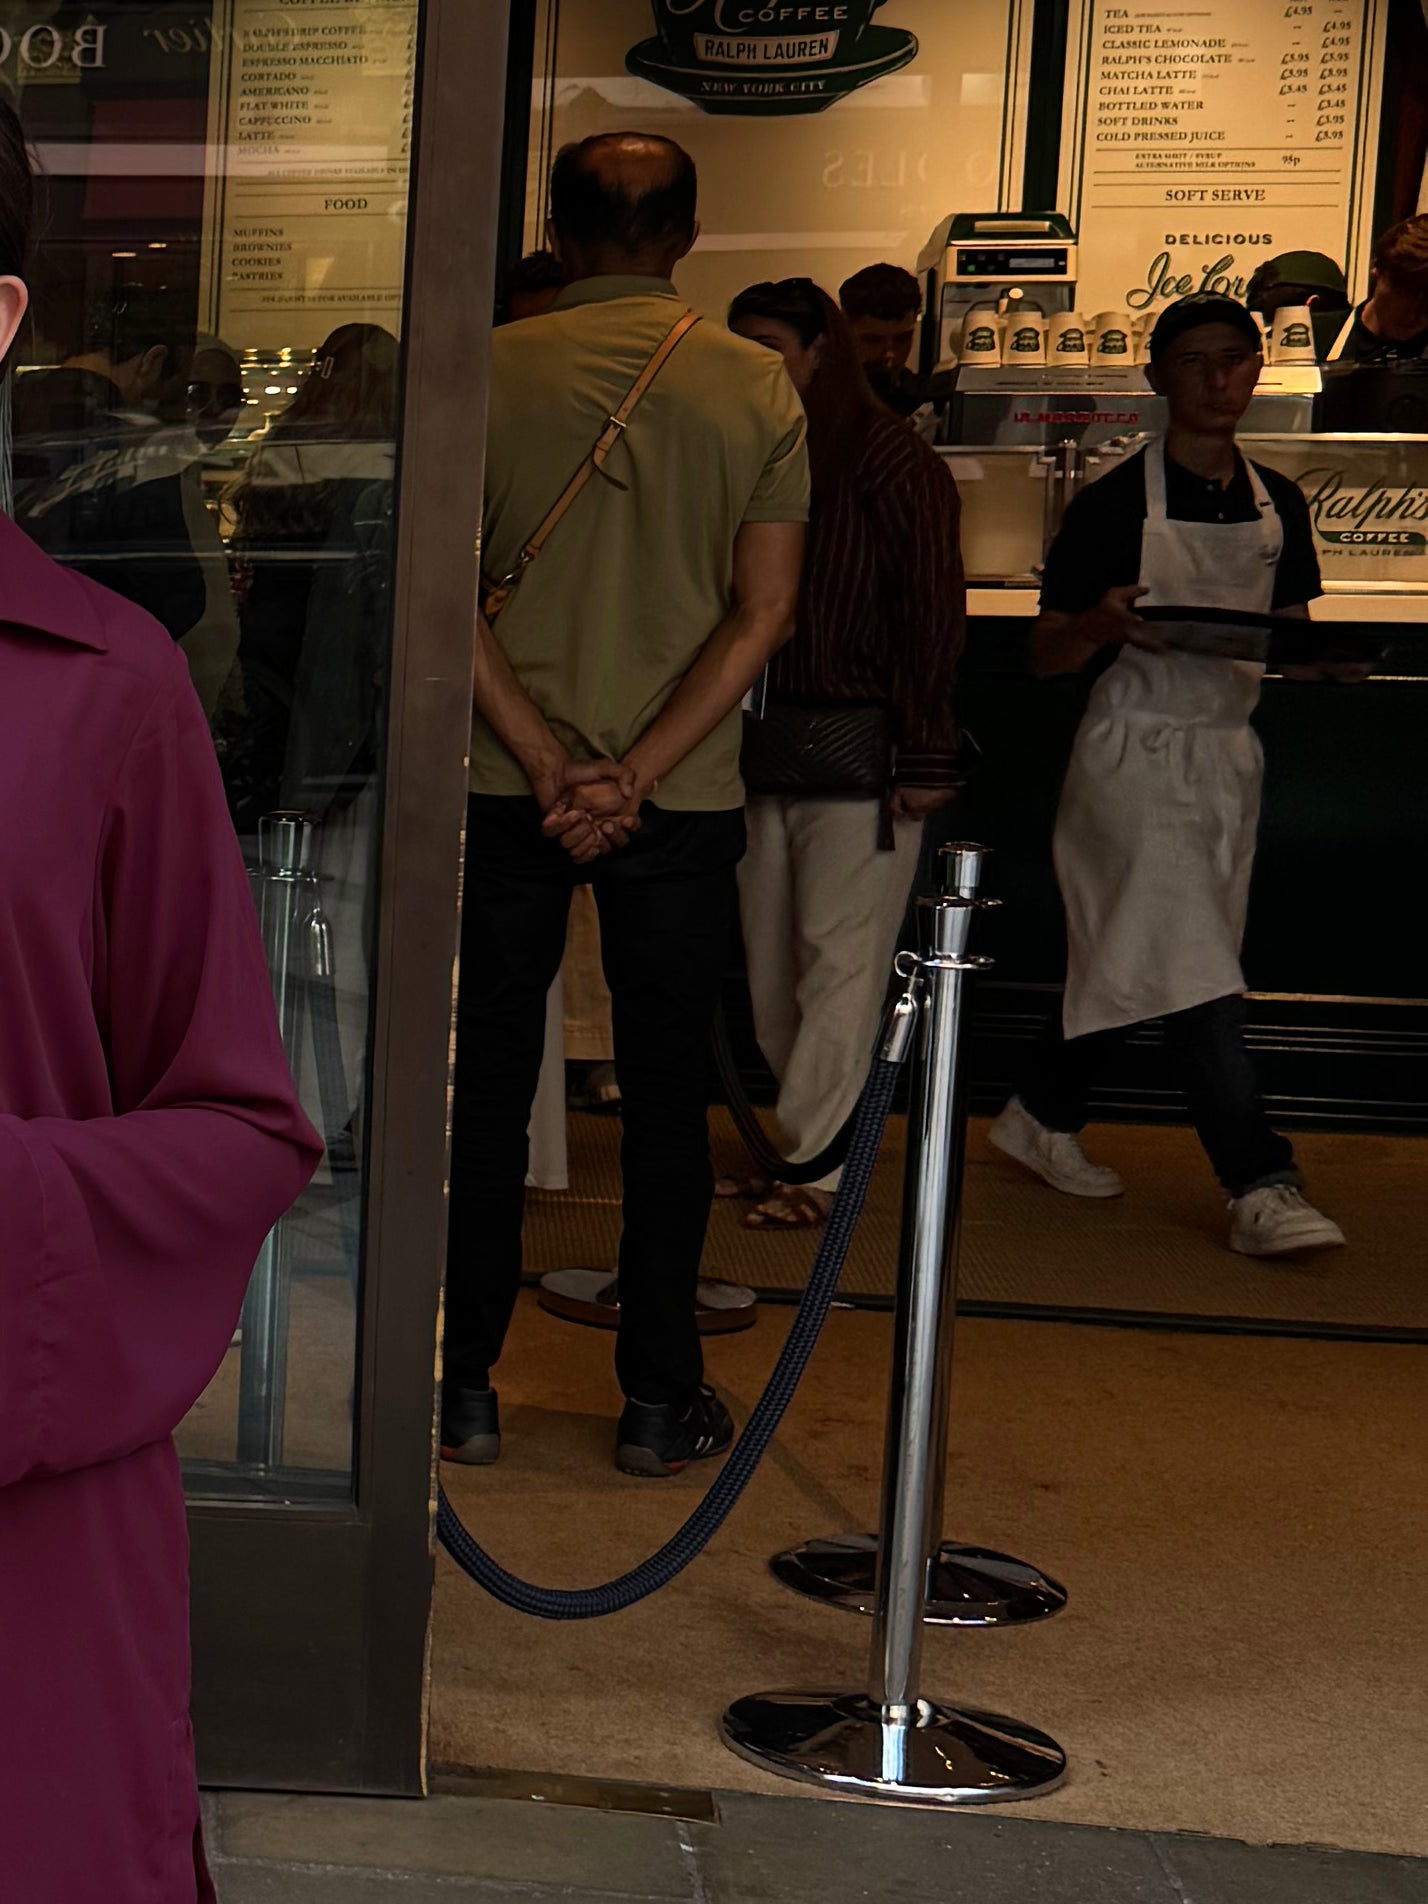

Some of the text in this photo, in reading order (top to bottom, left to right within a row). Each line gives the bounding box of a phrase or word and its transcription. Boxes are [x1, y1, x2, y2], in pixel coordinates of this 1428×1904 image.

[738, 6, 848, 22] COFFEE
[1105, 10, 1129, 19] TEA
[1104, 25, 1134, 34] ICED
[1136, 24, 1162, 34] TEA
[704, 37, 829, 60] RALPH LAUREN
[1102, 39, 1151, 49] CLASSIC
[1154, 38, 1227, 49] LEMONADE
[1101, 55, 1152, 65] RALPH'S
[1154, 54, 1232, 64] CHOCOLATE
[241, 71, 297, 82] CORTADO
[1101, 70, 1154, 80] MATCHA
[1156, 70, 1197, 80] LATTE
[240, 86, 309, 97] AMERICANO
[701, 80, 827, 94] NEW YORK CITY
[1099, 86, 1130, 95] CHAI
[1133, 85, 1174, 95] LATTE
[240, 101, 271, 111] FLAT
[271, 100, 309, 111] WHITE
[1098, 101, 1158, 111] BOTTLED
[1160, 100, 1204, 110] WATER
[239, 115, 312, 126] CAPPUCCINO
[1096, 116, 1128, 126] SOFT
[1132, 115, 1179, 126] DRINKS
[238, 131, 274, 141] LATTE
[1096, 132, 1131, 142] COLD
[1134, 131, 1187, 141] PRESSED
[1187, 130, 1226, 144] JUICE
[1164, 189, 1266, 202] SOFT SERVE
[324, 198, 368, 210] FOOD
[233, 228, 284, 238] MUFFINS
[1164, 233, 1273, 245] DELICIOUS
[233, 242, 292, 253] BROWNIES
[231, 257, 281, 267] COOKIES
[1339, 532, 1410, 544] COFFEE
